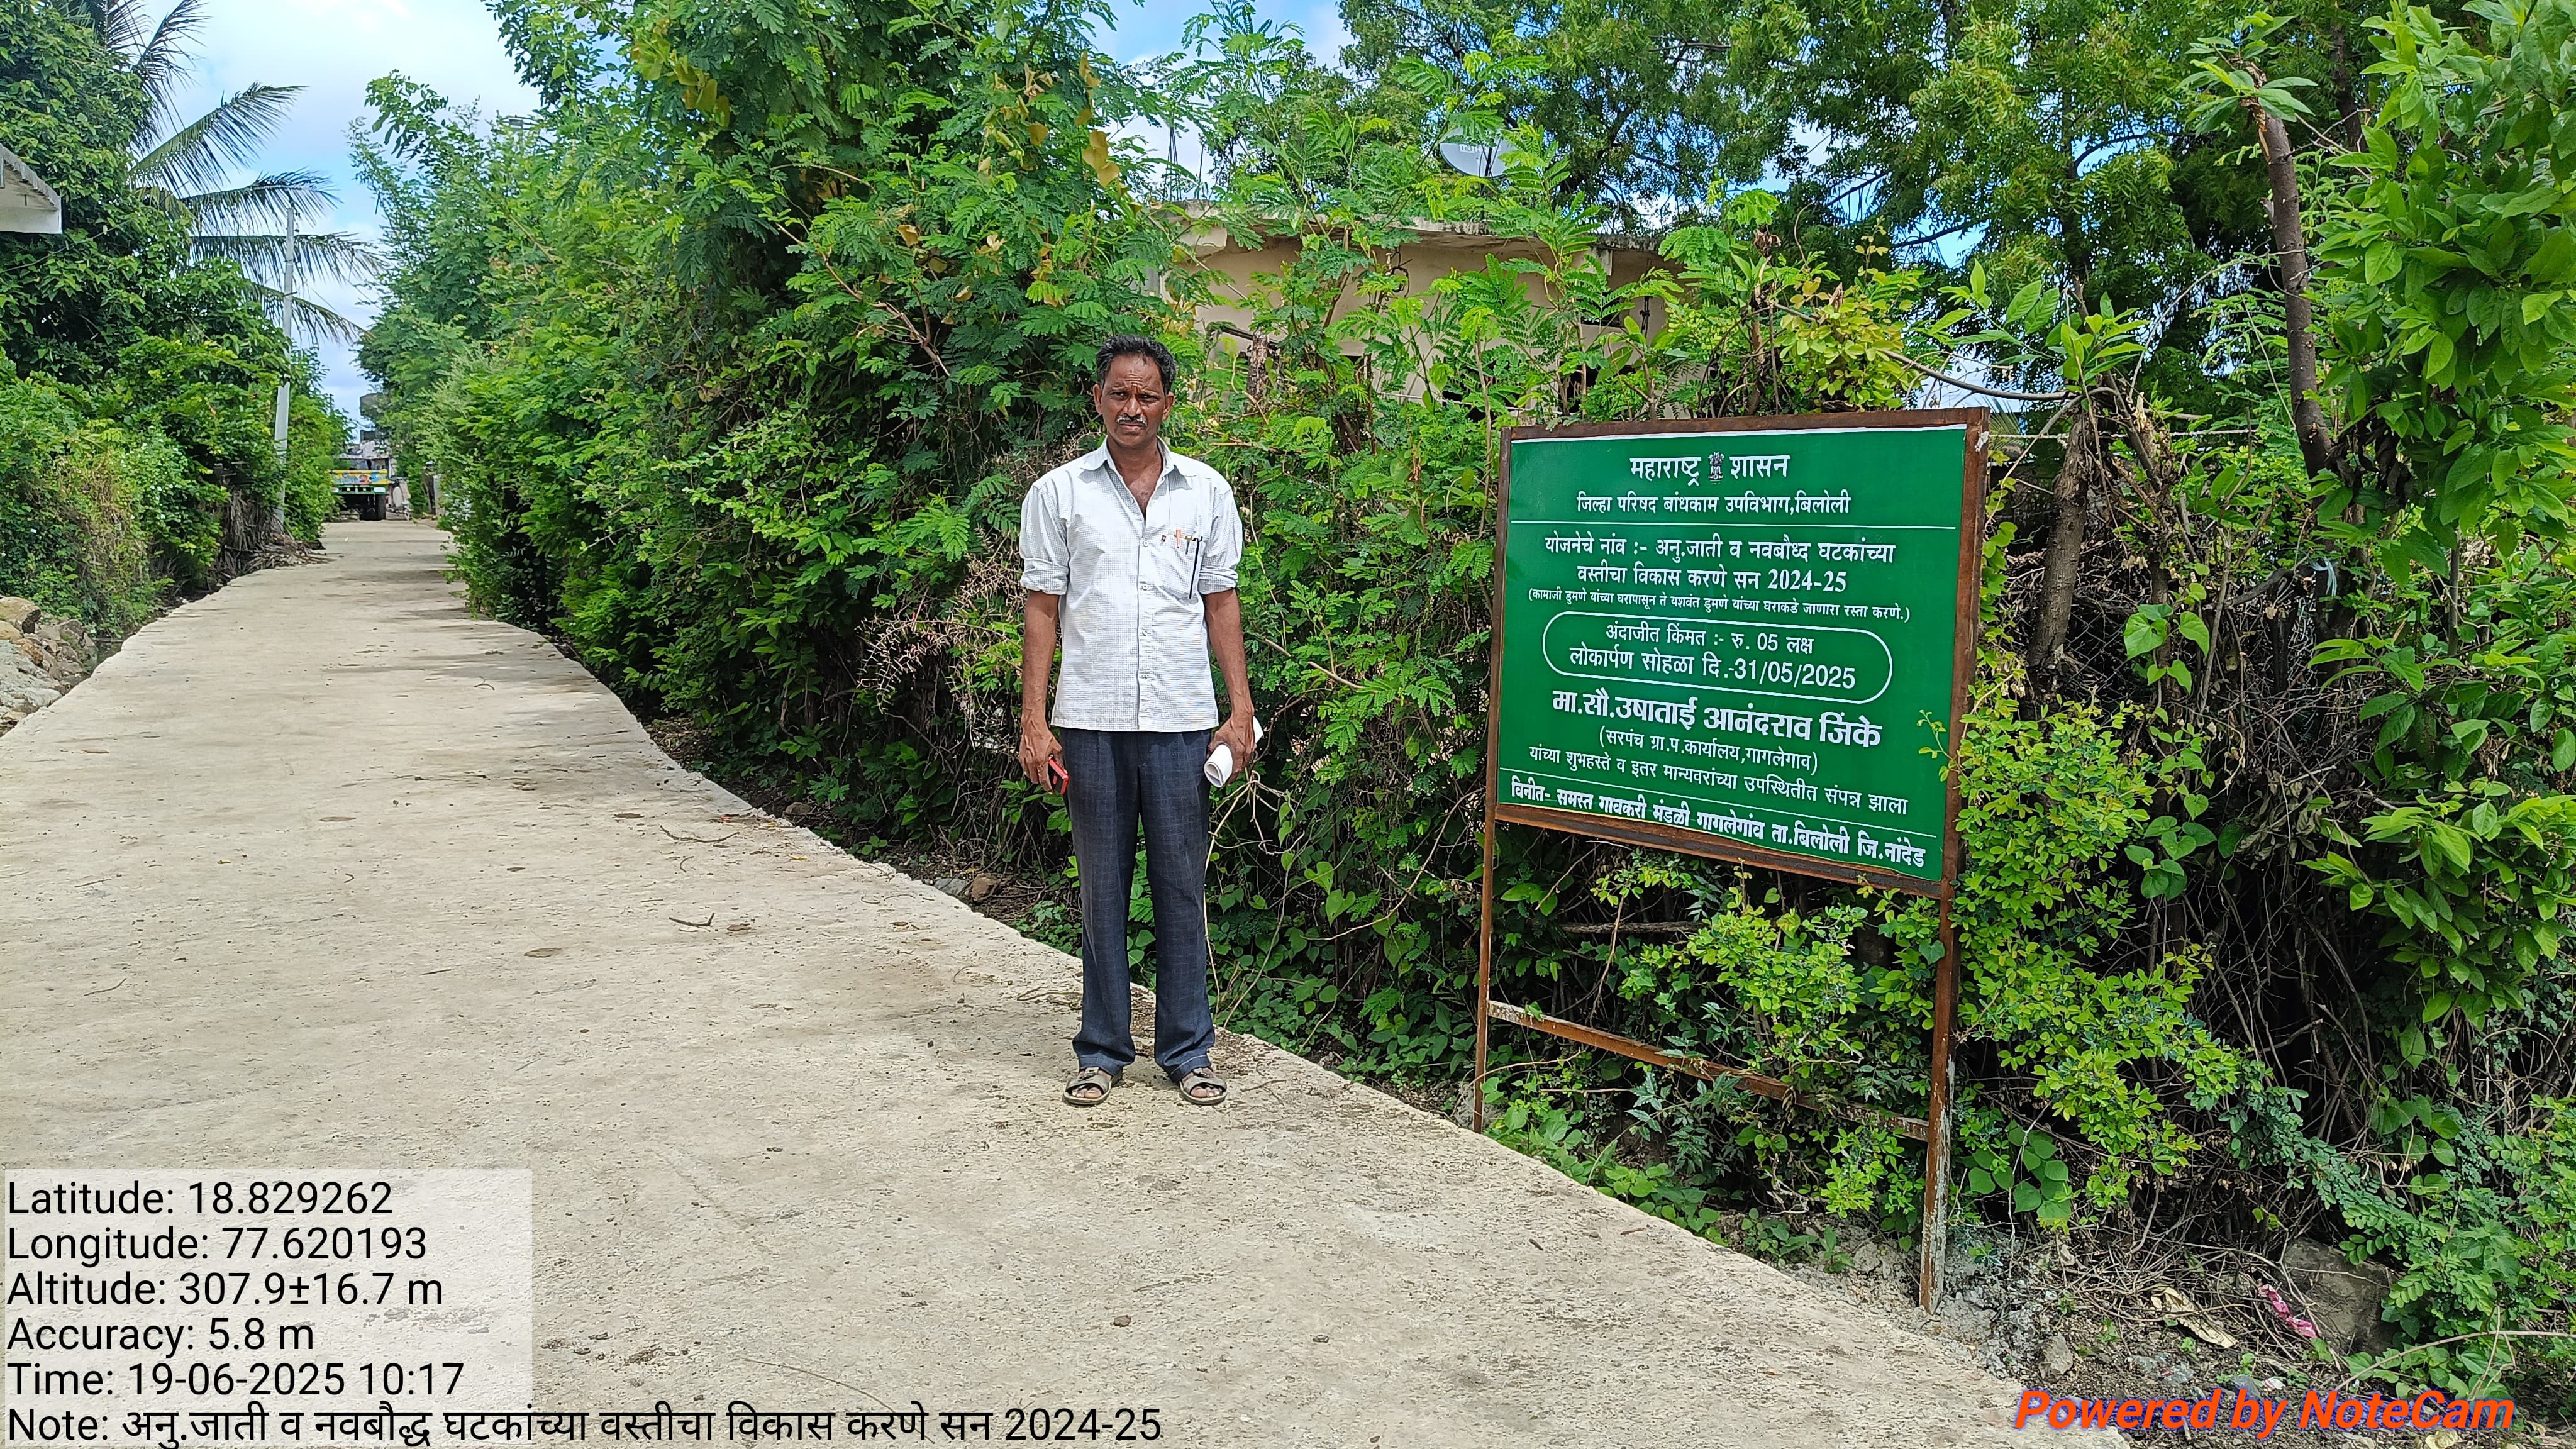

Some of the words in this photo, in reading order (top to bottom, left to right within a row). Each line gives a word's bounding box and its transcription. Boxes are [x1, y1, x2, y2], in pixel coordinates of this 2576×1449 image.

[1629, 457, 1701, 486] महाराष्ट्र
[1729, 455, 1790, 479] शासन
[1577, 491, 1613, 513] जिल्हा
[1617, 491, 1658, 514] परिषद
[1663, 491, 1719, 514] बांधकाम
[1545, 530, 1594, 554] योजनेचे
[1599, 532, 1627, 555] नांव
[1728, 541, 1743, 558] व
[1818, 536, 1896, 563] घटकांच्या
[1577, 559, 1628, 584] वस्तीचा
[1633, 560, 1681, 586] विकास
[1687, 564, 1727, 588] करणे
[1733, 571, 1761, 590] सन
[1767, 569, 1847, 592] 2024-25
[1528, 586, 1562, 601] (कामाजी
[1590, 589, 1614, 603] यांच्या
[1617, 594, 1656, 609] घरापासून
[1660, 591, 1667, 606] ते
[1670, 593, 1701, 608] यशवंत
[1732, 596, 1760, 611] यांच्या
[1763, 598, 1799, 614] घराकडे
[1802, 602, 1840, 616] जाणारा
[1844, 605, 1868, 618] रस्ता
[1606, 620, 1660, 643] अंदाजीत
[1757, 633, 1779, 652] 05
[1786, 636, 1814, 655] लक्ष
[1569, 641, 1635, 670] लोकार्पण
[1641, 647, 1695, 675] सोहळा
[1599, 725, 1645, 748] (सरपंच
[1703, 702, 1813, 741] आनंदराव
[1530, 743, 1560, 763] यांच्या
[1566, 751, 1611, 772] शुभहस्ते
[1616, 758, 1626, 773] व
[1631, 760, 1657, 779] इतर
[1663, 766, 1738, 790] मान्यवरांच्या
[1744, 774, 1818, 801] उपस्थितीत
[1824, 784, 1862, 808] संपन्न
[1868, 794, 1909, 815] झाला
[1511, 775, 1551, 802] विनीत-
[1557, 789, 1594, 810] समस्त
[1599, 794, 1647, 820] गावकरी
[1653, 798, 1691, 827] मंडळी
[1697, 809, 1765, 840] गागलेगांव
